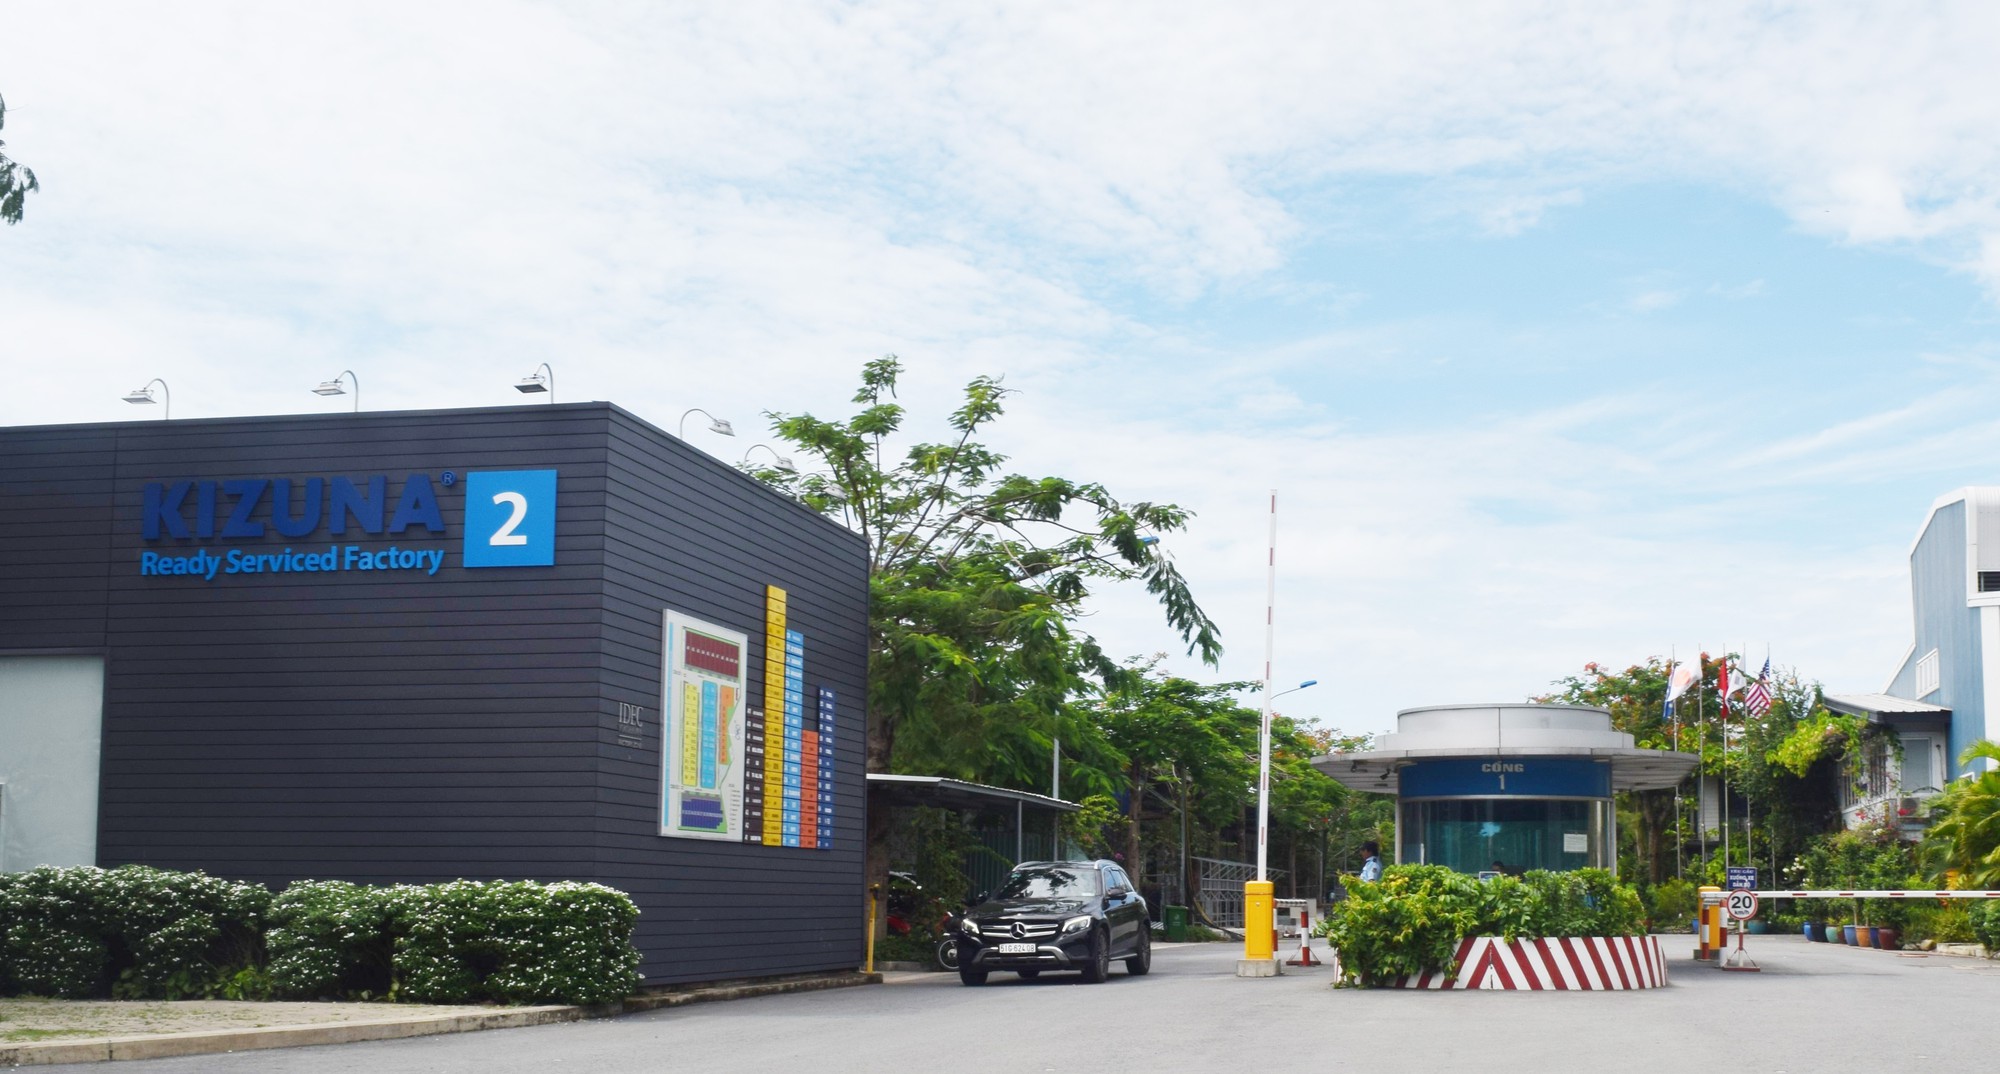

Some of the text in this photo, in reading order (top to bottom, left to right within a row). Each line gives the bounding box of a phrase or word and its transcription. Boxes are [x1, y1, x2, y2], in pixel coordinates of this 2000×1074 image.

[489, 491, 528, 546] 2
[141, 545, 445, 581] Ready Serviced Factory
[1498, 774, 1505, 790] 1
[1731, 896, 1752, 909] 20
